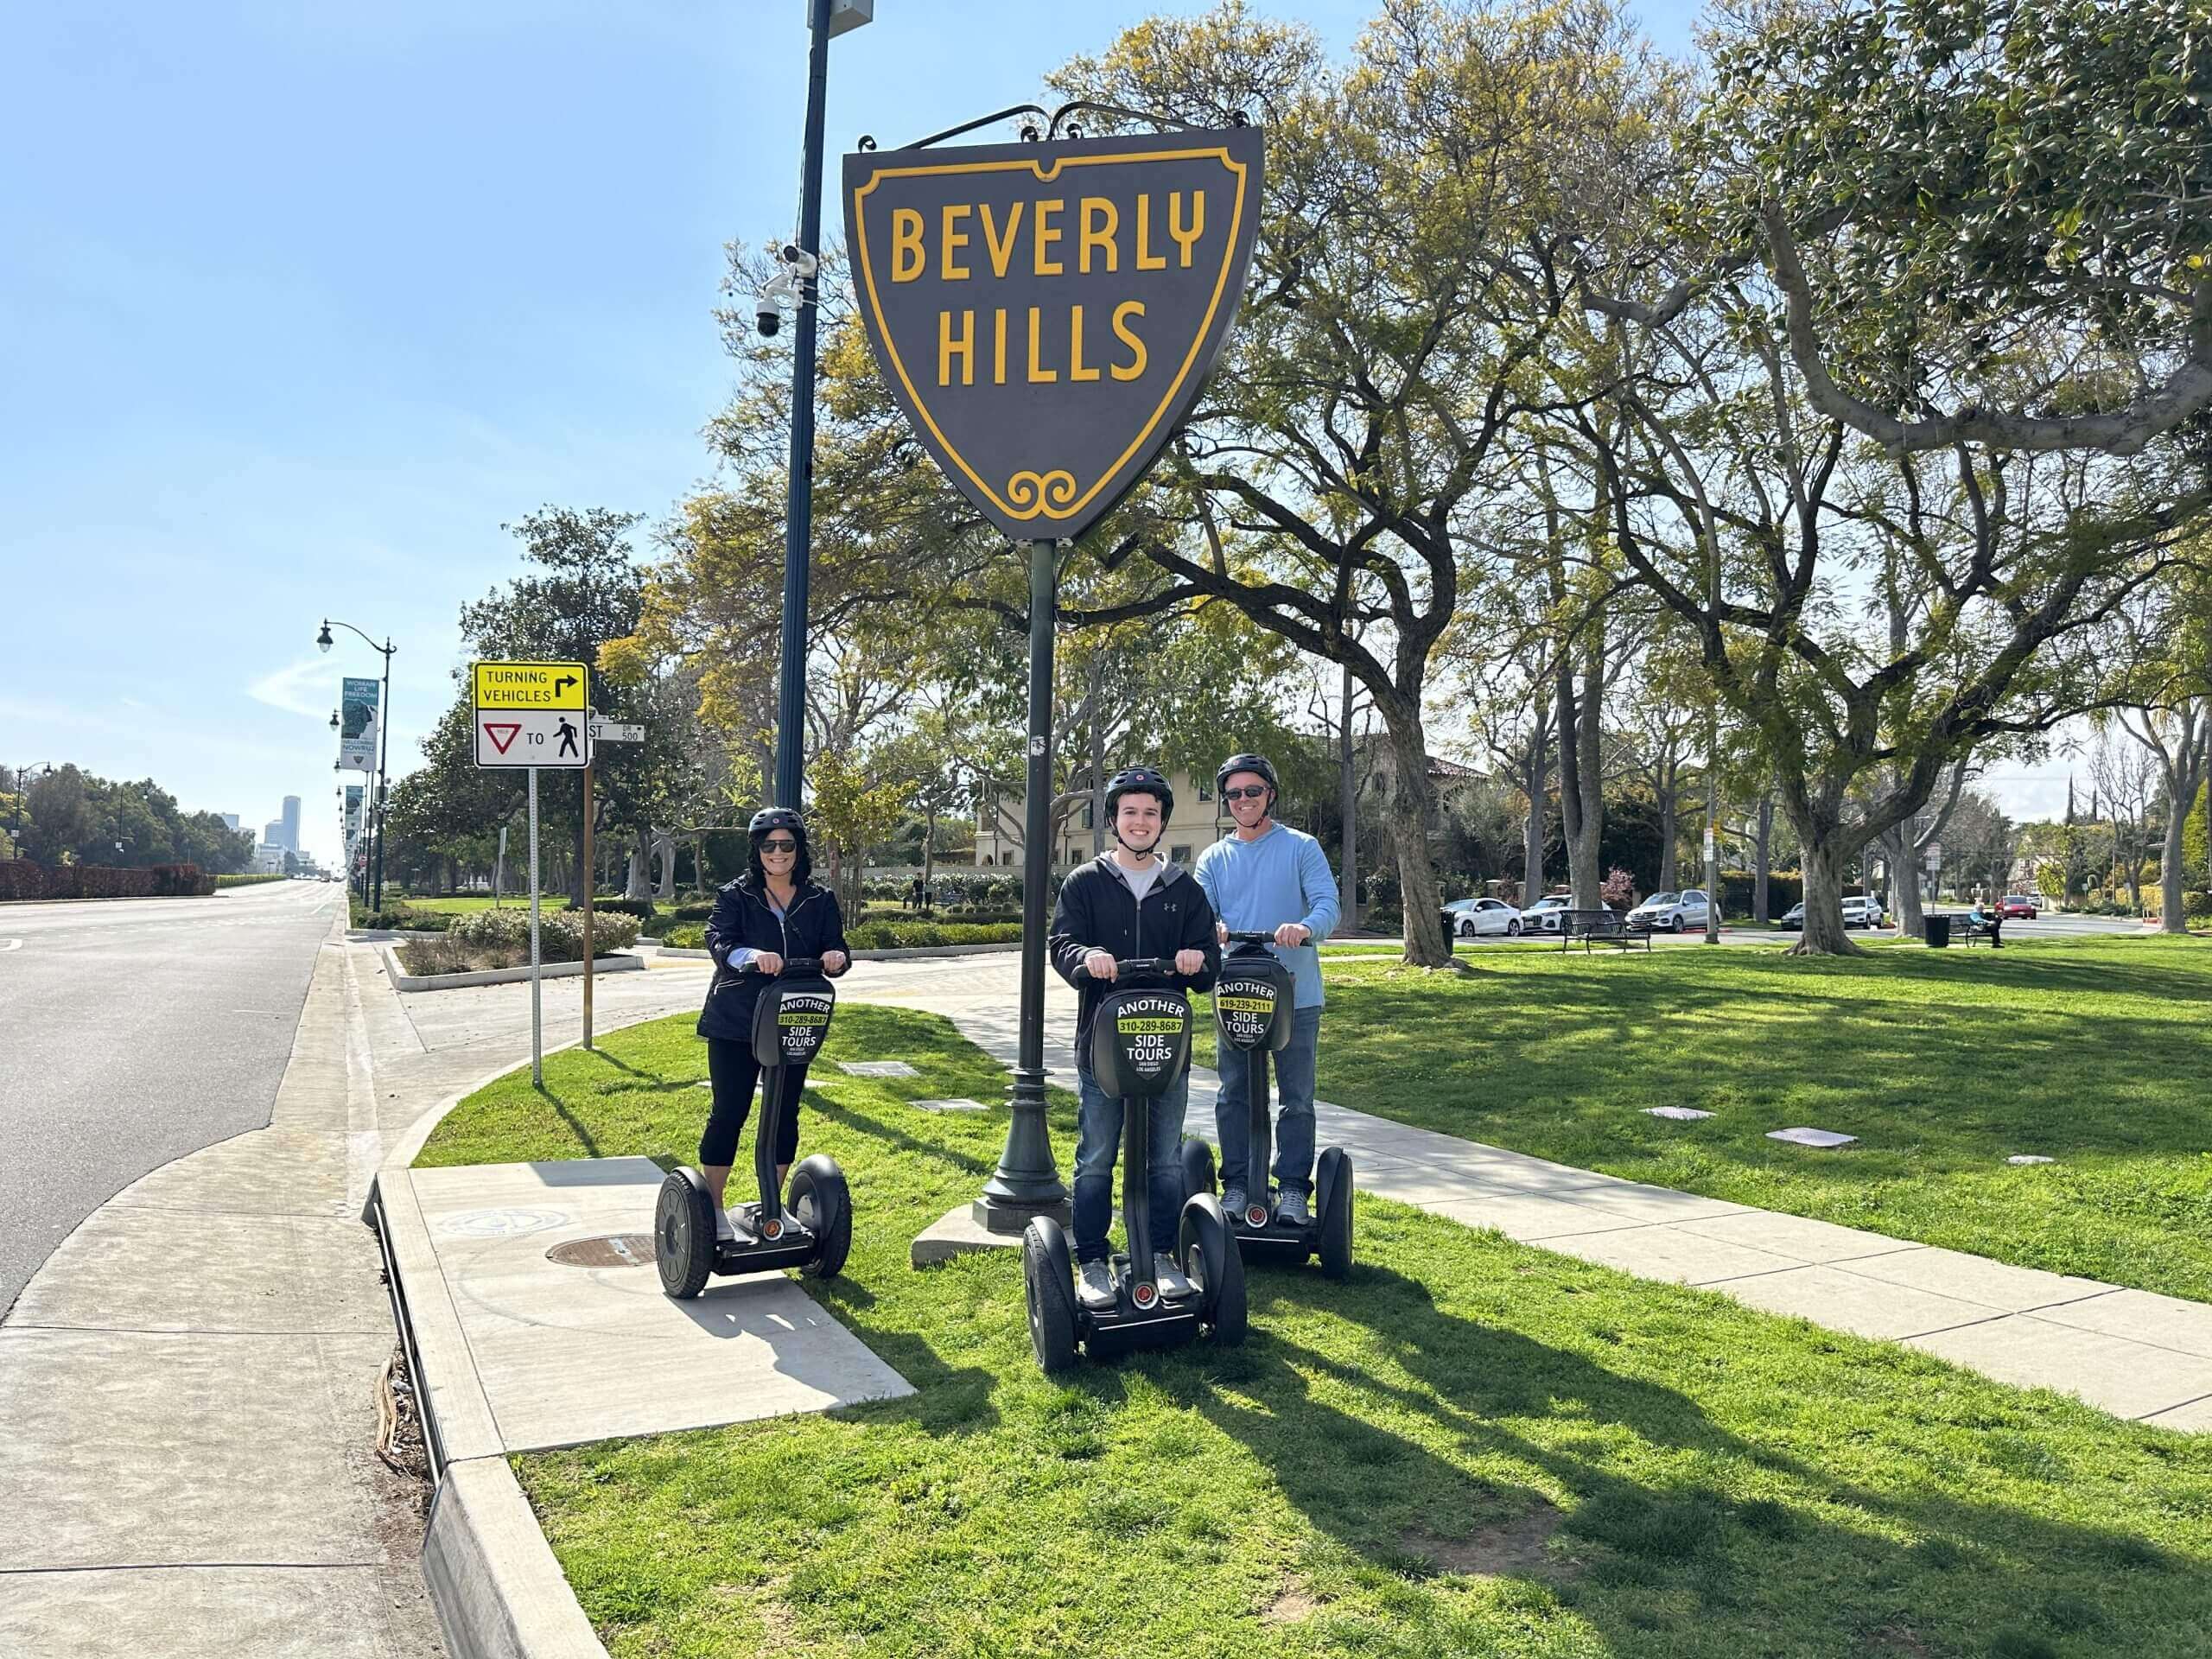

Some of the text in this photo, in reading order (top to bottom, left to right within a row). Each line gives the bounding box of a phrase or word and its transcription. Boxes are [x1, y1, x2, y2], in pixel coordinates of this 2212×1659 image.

[892, 190, 1205, 283] BEVERLY
[938, 301, 1148, 386] HILLS
[486, 671, 547, 683] TURNING
[484, 690, 551, 702] VEHICLES
[526, 733, 544, 745] TO
[622, 732, 639, 741] 500
[1217, 982, 1274, 999] ANOTHER
[779, 999, 830, 1014] ANOTHER
[1117, 1000, 1185, 1018] ANOTHER
[1220, 999, 1270, 1011] 619-239-2111
[779, 1015, 827, 1024] 310-289-8687
[1232, 1011, 1258, 1023] SIDE
[789, 1027, 812, 1036] SIDE
[1120, 1020, 1182, 1032] 310-289-8687
[1225, 1021, 1265, 1034] TOURS
[782, 1036, 817, 1046] TOURS
[1135, 1035, 1165, 1047] SIDE
[1127, 1047, 1172, 1061] TOURS
